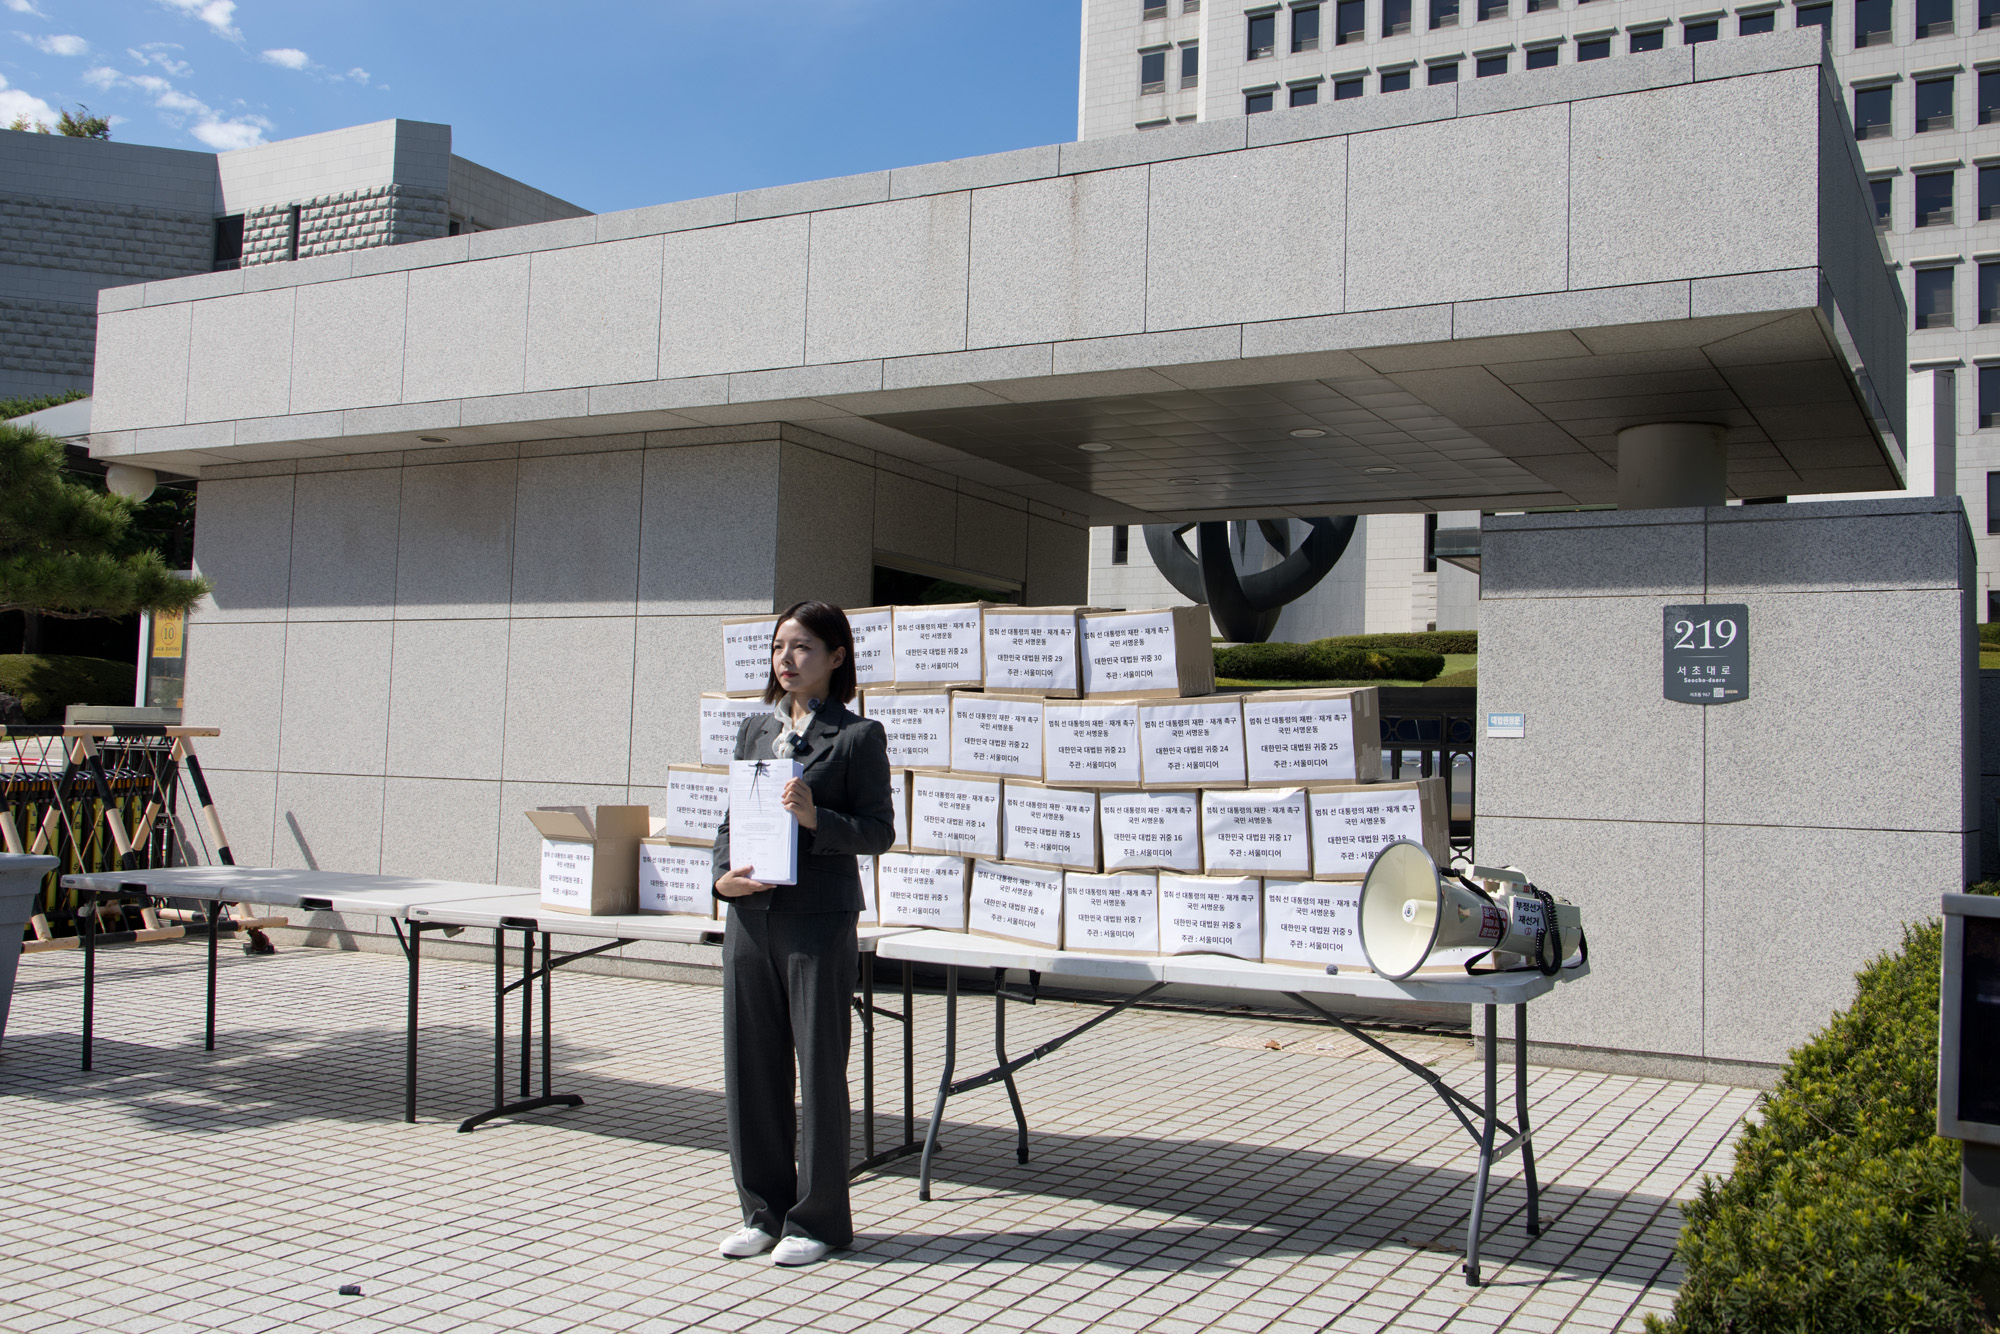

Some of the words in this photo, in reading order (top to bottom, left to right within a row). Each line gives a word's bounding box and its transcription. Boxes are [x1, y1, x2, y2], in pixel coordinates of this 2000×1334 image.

[164, 627, 174, 640] 10
[1674, 619, 1737, 650] 219
[905, 648, 928, 656] 대한민국
[947, 647, 960, 655] 귀중
[1021, 654, 1040, 662] 대법원
[1041, 654, 1054, 662] 귀중
[1094, 656, 1119, 666] 대한민국
[1119, 656, 1139, 664] 대법원
[1140, 654, 1153, 662] 귀중
[1676, 666, 1731, 676] 서초대로
[888, 732, 899, 740] 민국
[964, 737, 988, 746] 대한민국
[988, 739, 1007, 748] 대법원
[1008, 740, 1020, 748] 귀중
[1260, 744, 1289, 752] 대한민국
[1290, 743, 1312, 752] 대법원
[1312, 743, 1328, 751] 귀중
[1058, 746, 1083, 754] 대한민국
[1155, 746, 1182, 755] 대한민국
[1183, 746, 1204, 754] 대법원
[1204, 745, 1219, 753] 귀중
[1167, 762, 1181, 770] 주관
[1186, 760, 1219, 770] 서울미디어
[1273, 760, 1288, 768] 주관
[1293, 758, 1328, 768] 서울미디어
[1113, 833, 1137, 842] 대한민국
[1138, 834, 1158, 842] 대법원
[1158, 834, 1172, 842] 귀중
[1218, 833, 1244, 842] 대한민국
[1246, 833, 1266, 842] 대법원
[1268, 834, 1282, 842] 귀중
[1327, 836, 1356, 844] 대한민국
[1357, 834, 1380, 844] 대법원
[1380, 834, 1396, 842] 귀중
[1078, 914, 1102, 922] 대한민국
[1102, 915, 1122, 923] 대법원
[1518, 915, 1540, 927] 재선거
[1173, 918, 1198, 928] 대한민국
[1199, 920, 1220, 928] 대법원
[1221, 921, 1236, 930] 귀중
[1280, 923, 1308, 933] 대한민국
[1308, 926, 1330, 935] 대법원
[1332, 927, 1347, 936] 귀중
